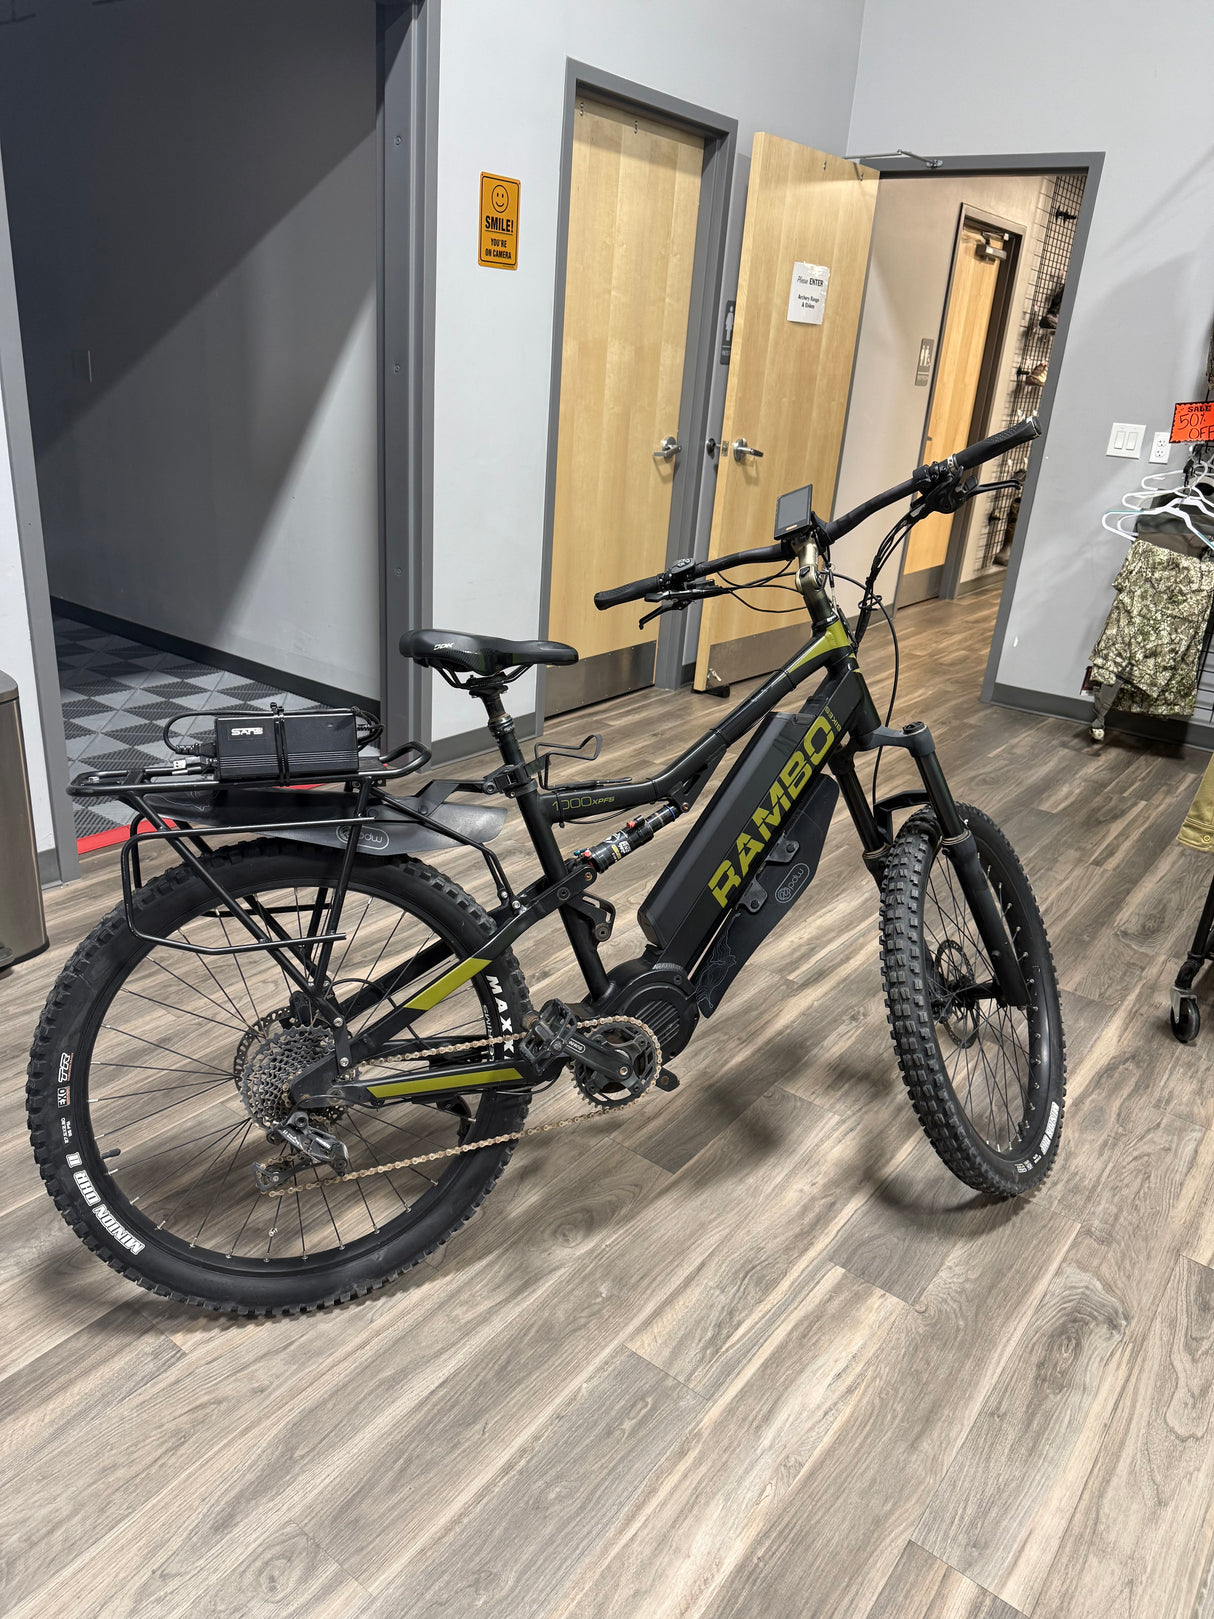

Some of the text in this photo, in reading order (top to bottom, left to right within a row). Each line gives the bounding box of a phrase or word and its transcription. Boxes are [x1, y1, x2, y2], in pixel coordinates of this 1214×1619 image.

[485, 215, 514, 233] SMILE!
[490, 238, 507, 248] YOU'RE
[485, 248, 512, 259] ON CAMERA
[809, 278, 824, 287] ENTER
[1187, 405, 1212, 413] SALE
[1178, 413, 1206, 430] 50%
[1188, 425, 1214, 440] OFF
[707, 715, 835, 909] RAMBO
[73, 1169, 101, 1207] DHR
[92, 1203, 146, 1256] MINION
